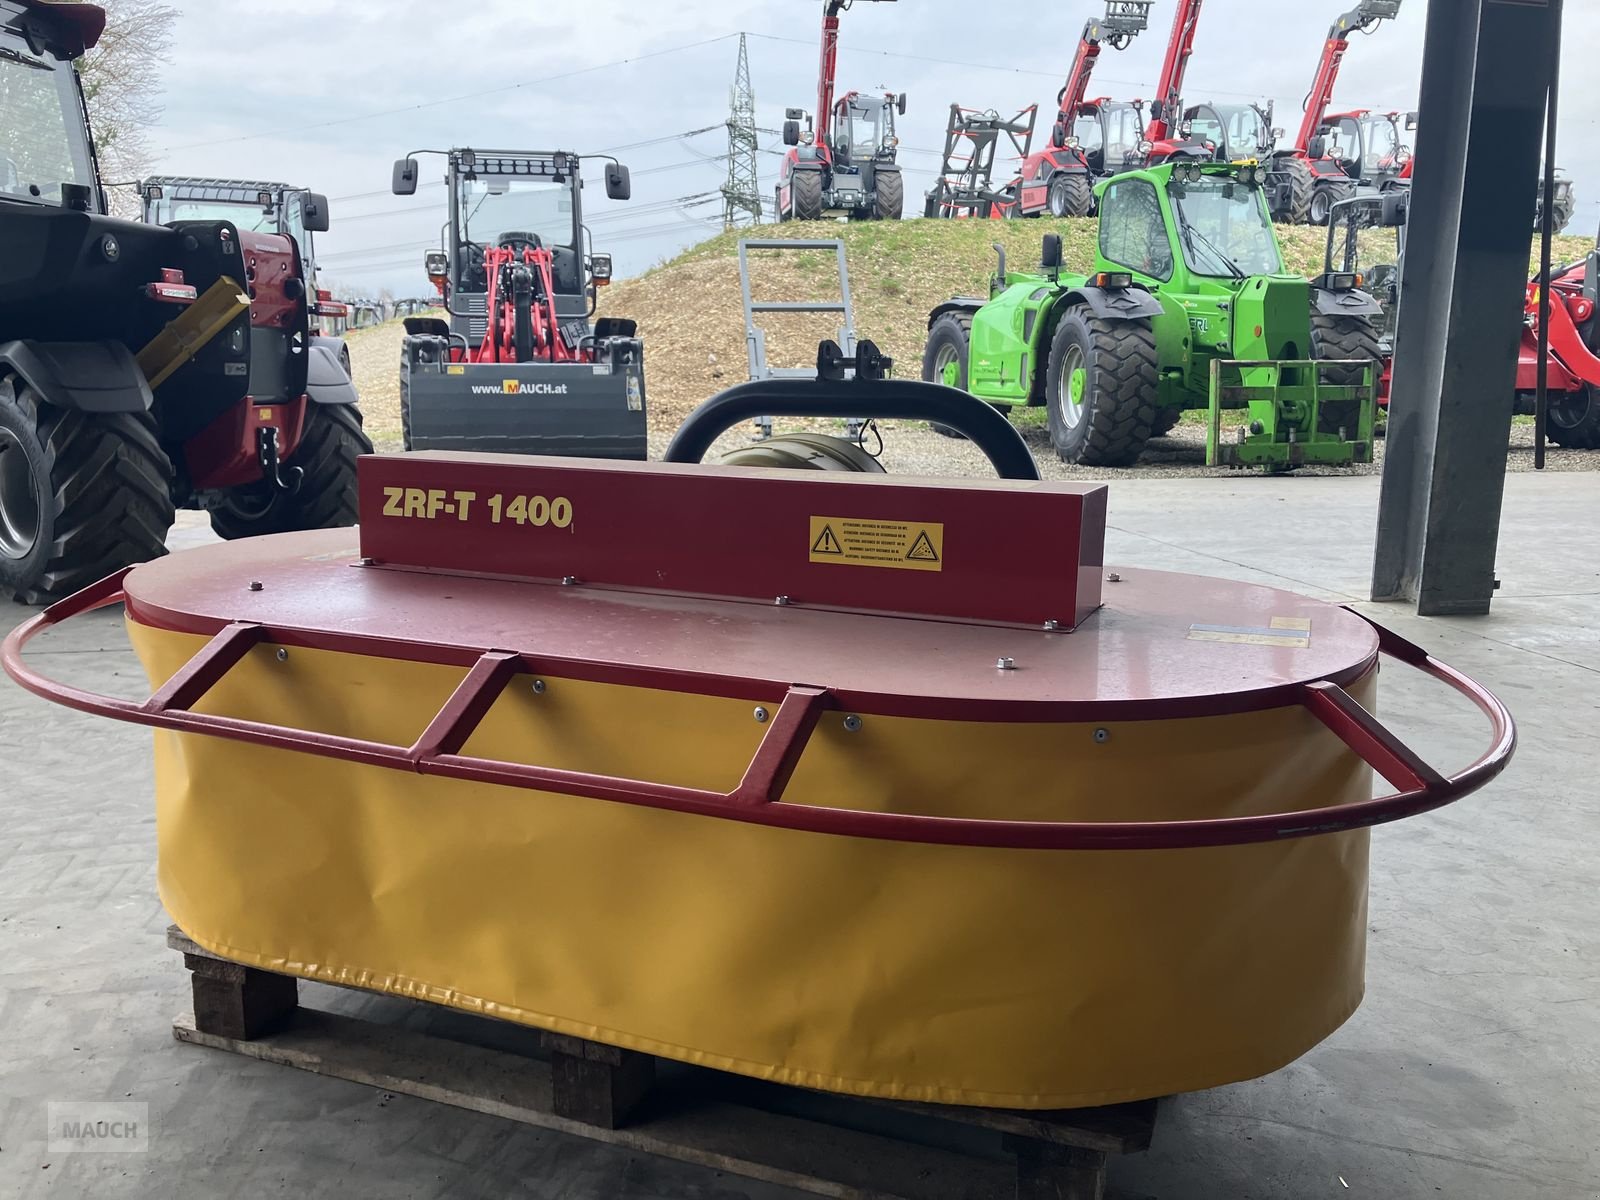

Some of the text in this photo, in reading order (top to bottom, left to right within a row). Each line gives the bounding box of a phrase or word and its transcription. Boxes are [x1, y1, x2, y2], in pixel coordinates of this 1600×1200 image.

[1188, 317, 1208, 332] ERL
[471, 382, 568, 394] www.MAUCH.at
[382, 486, 573, 528] ZRF-T 1400
